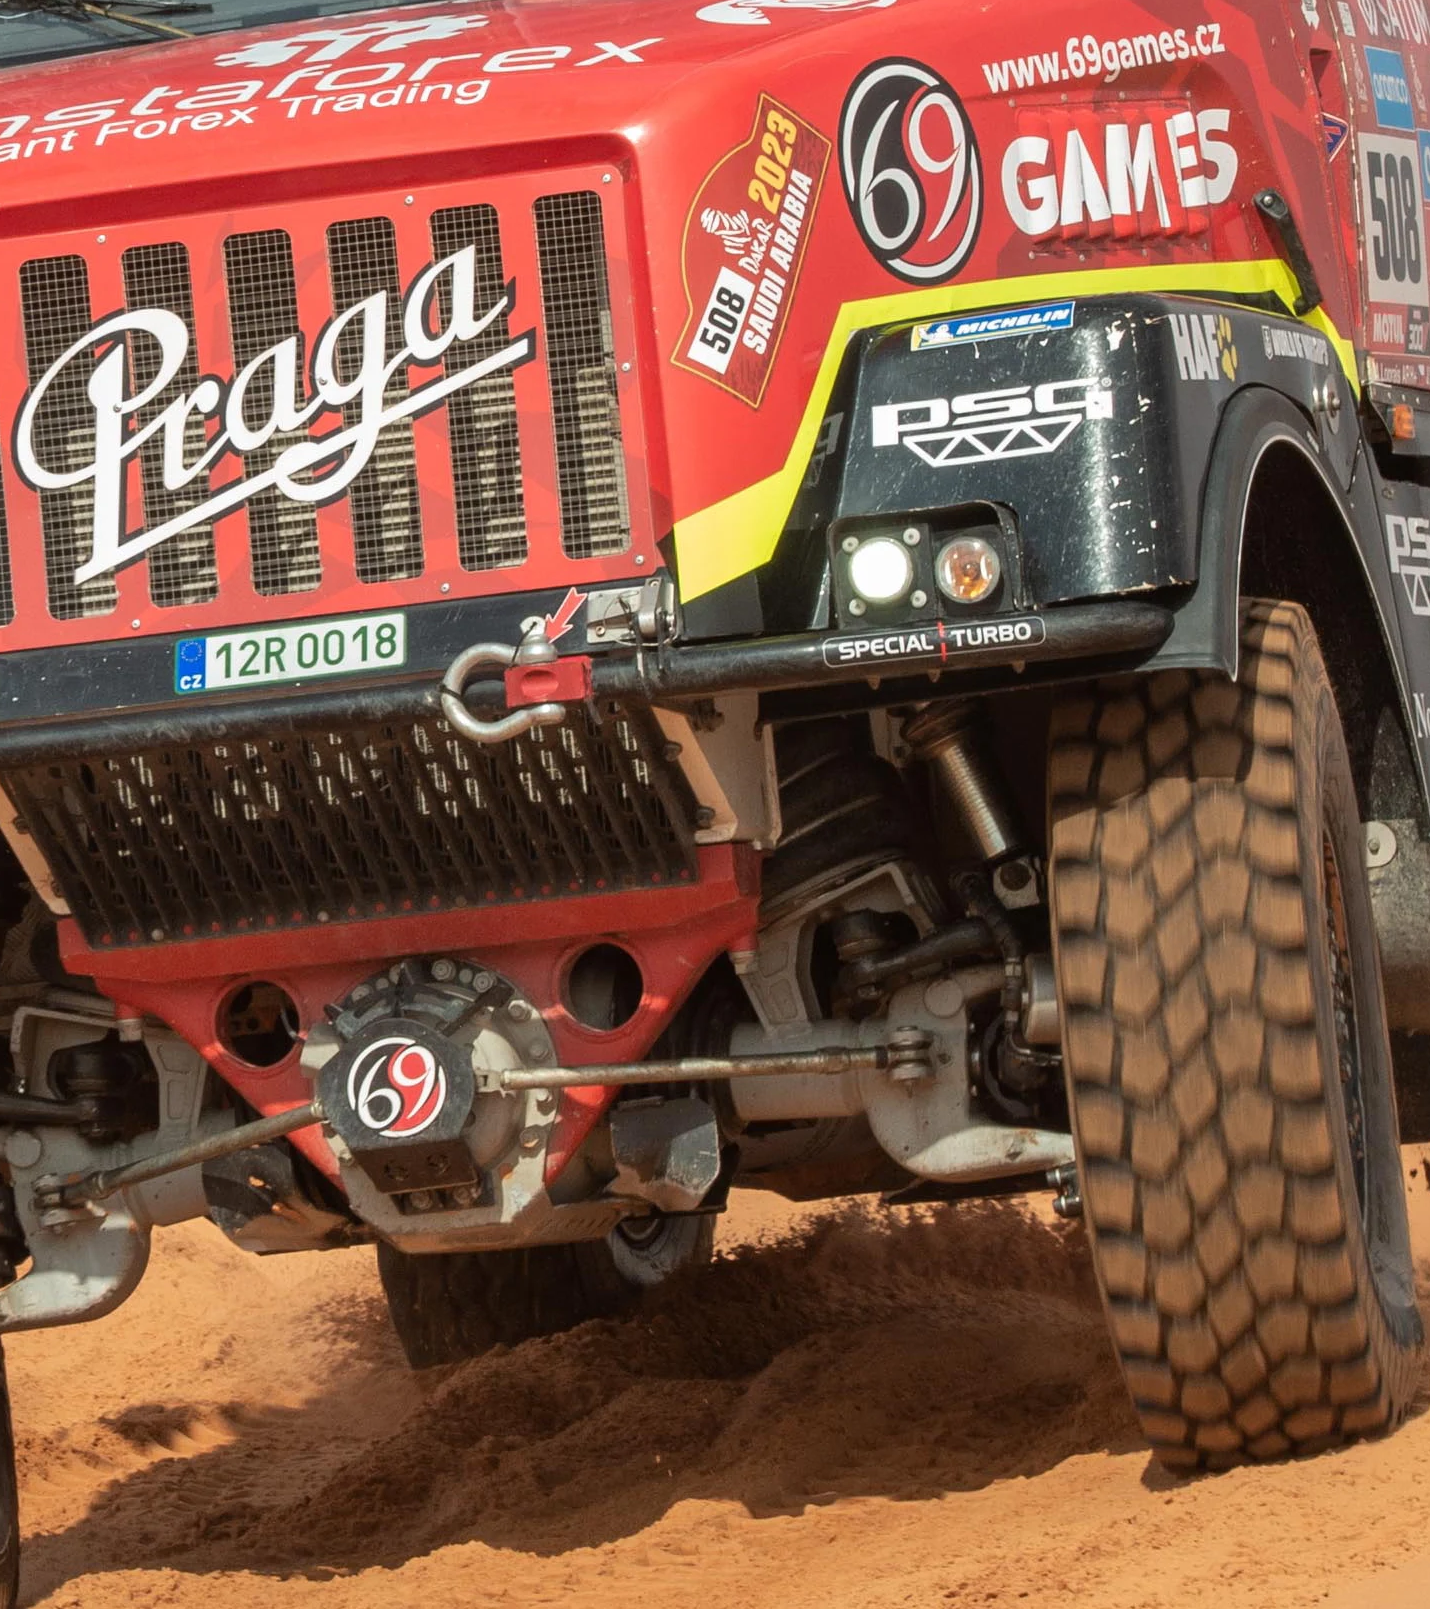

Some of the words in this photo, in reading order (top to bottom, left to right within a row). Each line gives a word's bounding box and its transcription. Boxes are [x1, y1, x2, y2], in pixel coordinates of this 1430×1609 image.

[982, 22, 1225, 94] www.69games.cz
[95, 105, 258, 146] Forex
[280, 79, 490, 119] Trading
[747, 110, 798, 215] 2023
[852, 81, 975, 261] 69
[1001, 108, 1238, 235] GAMES
[737, 218, 774, 276] DAKAR
[1367, 152, 1422, 284] 508
[741, 268, 788, 355] SAUDI
[772, 168, 814, 271] ARABIA
[697, 286, 745, 356] 508
[956, 307, 1070, 336] MICHELIN
[1168, 313, 1220, 381] HAF
[1271, 329, 1297, 358] WORLD
[1373, 313, 1404, 344] MOTUL
[16, 244, 529, 585] Praga
[215, 637, 286, 680] 12R
[297, 622, 398, 669] 0018
[839, 634, 934, 660] SPECIAL
[951, 621, 1032, 647] TURBO
[180, 674, 202, 690] CZ
[352, 1041, 440, 1133] 69
